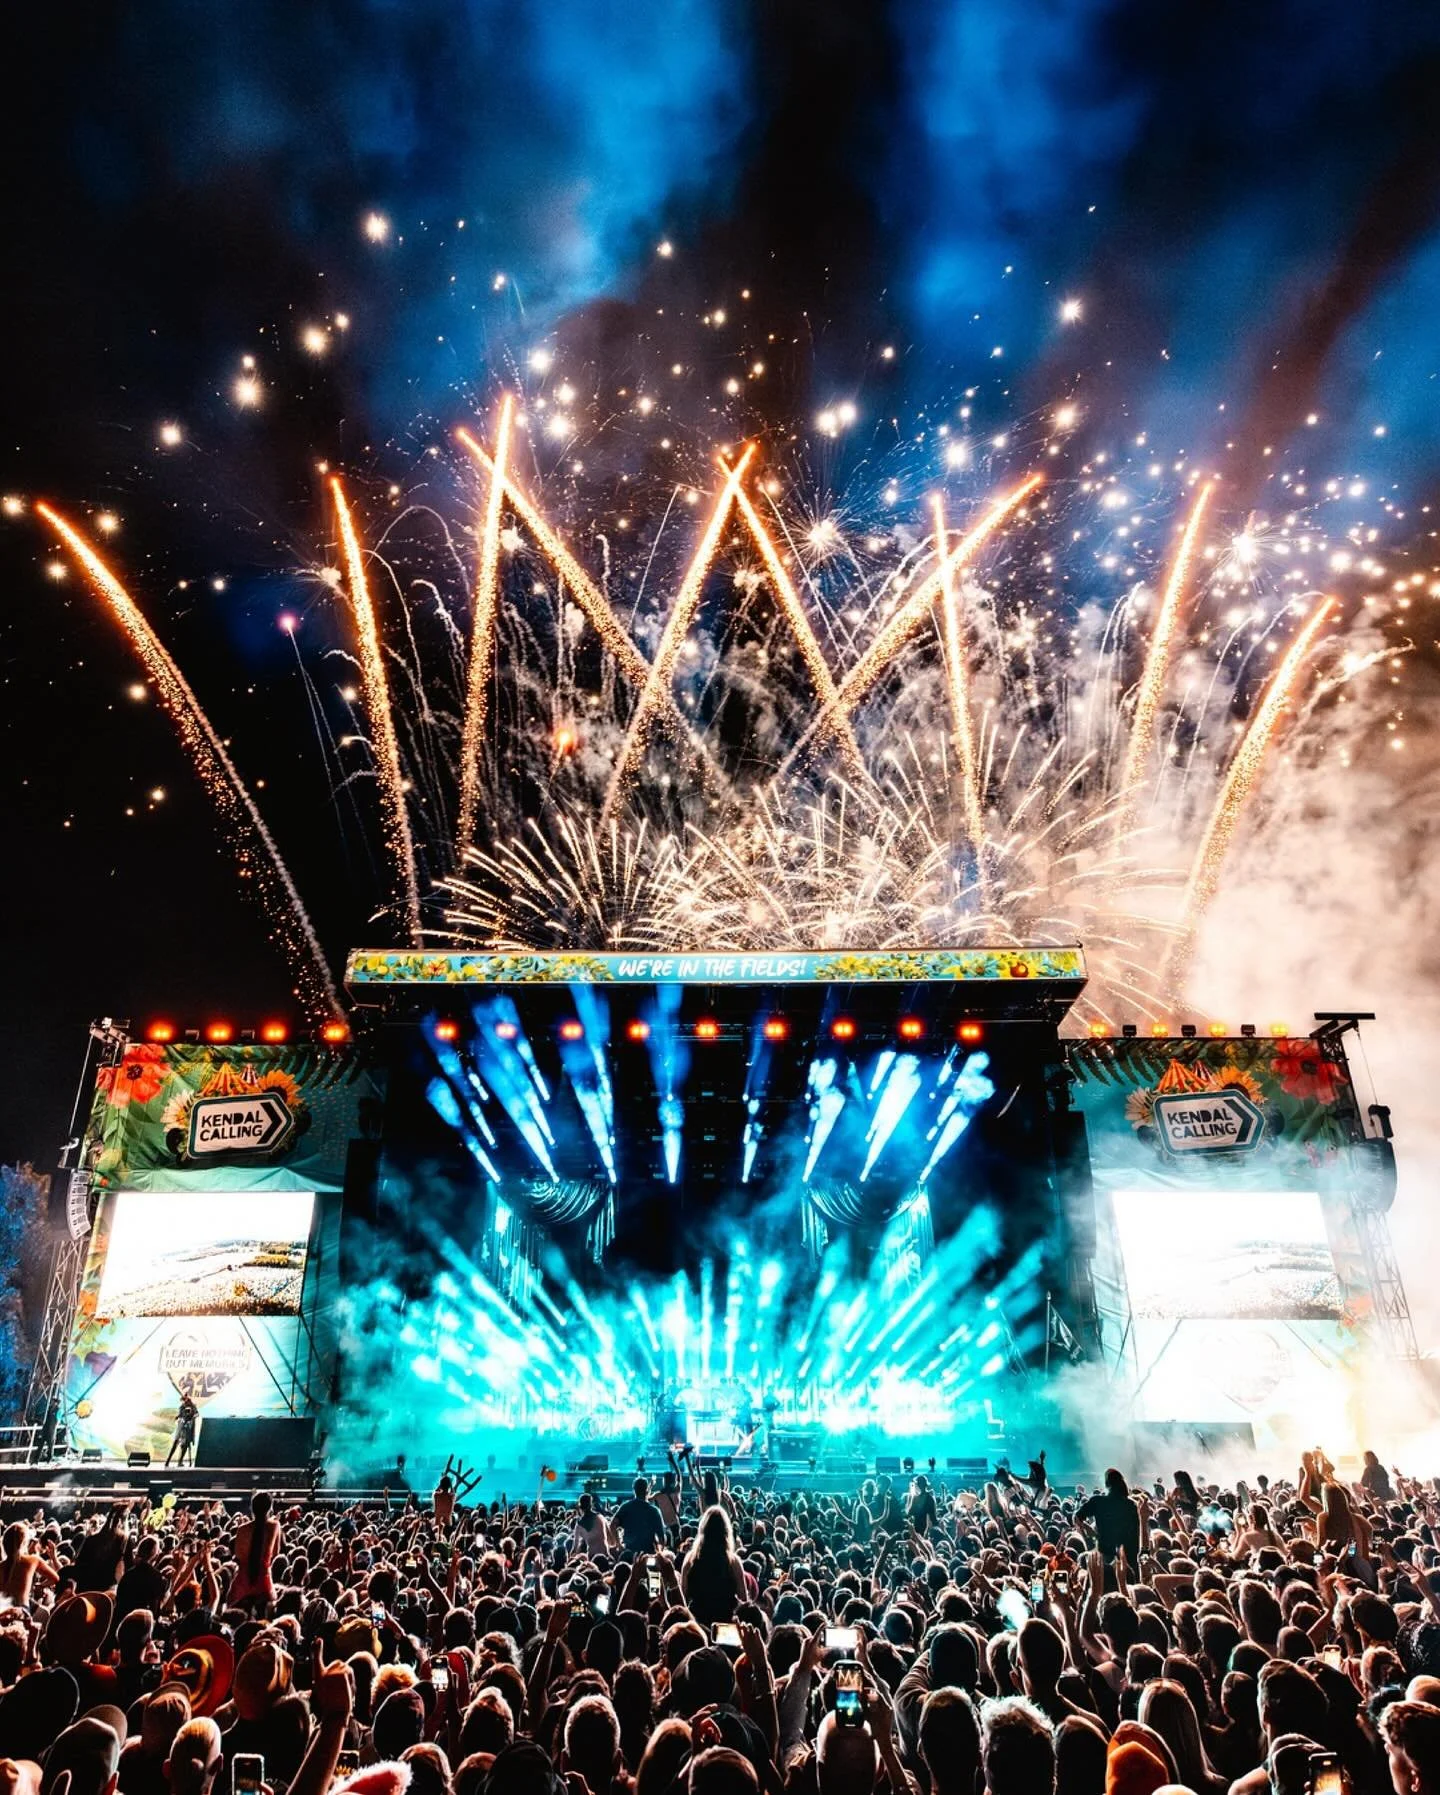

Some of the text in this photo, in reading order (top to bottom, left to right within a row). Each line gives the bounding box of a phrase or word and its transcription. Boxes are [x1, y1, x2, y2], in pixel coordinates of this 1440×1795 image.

[618, 958, 808, 977] WE'RE IN THE FIELDS!
[201, 1110, 264, 1128] KENDAL
[1167, 1108, 1233, 1125] KENDAL
[200, 1125, 263, 1141] CALLING
[1172, 1122, 1238, 1139] CALLING
[165, 1349, 198, 1358] LEAVE
